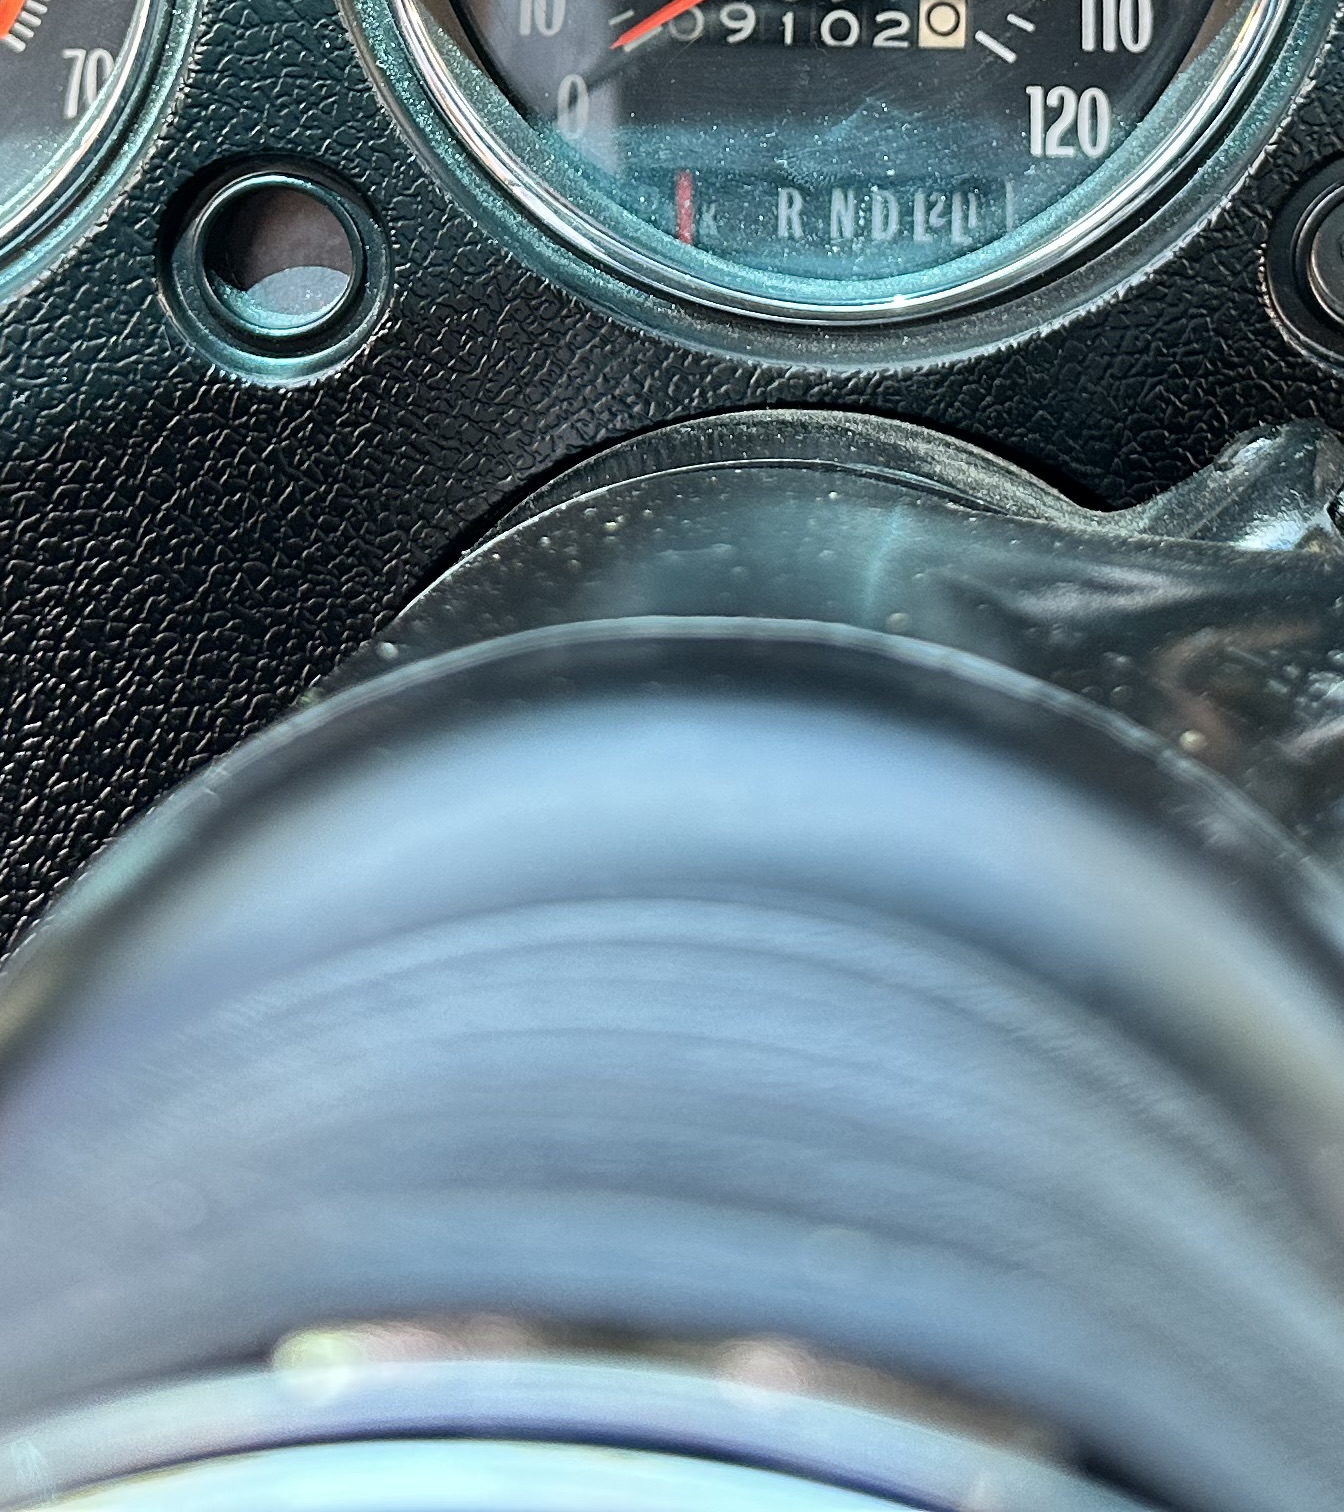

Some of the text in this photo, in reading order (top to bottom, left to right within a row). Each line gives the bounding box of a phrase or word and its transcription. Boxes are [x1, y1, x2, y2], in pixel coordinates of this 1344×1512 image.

[62, 48, 114, 119] 70
[558, 75, 589, 139] 0
[1027, 86, 1111, 157] 120
[777, 188, 805, 239] R
[830, 188, 856, 239] N
[871, 189, 899, 240] D
